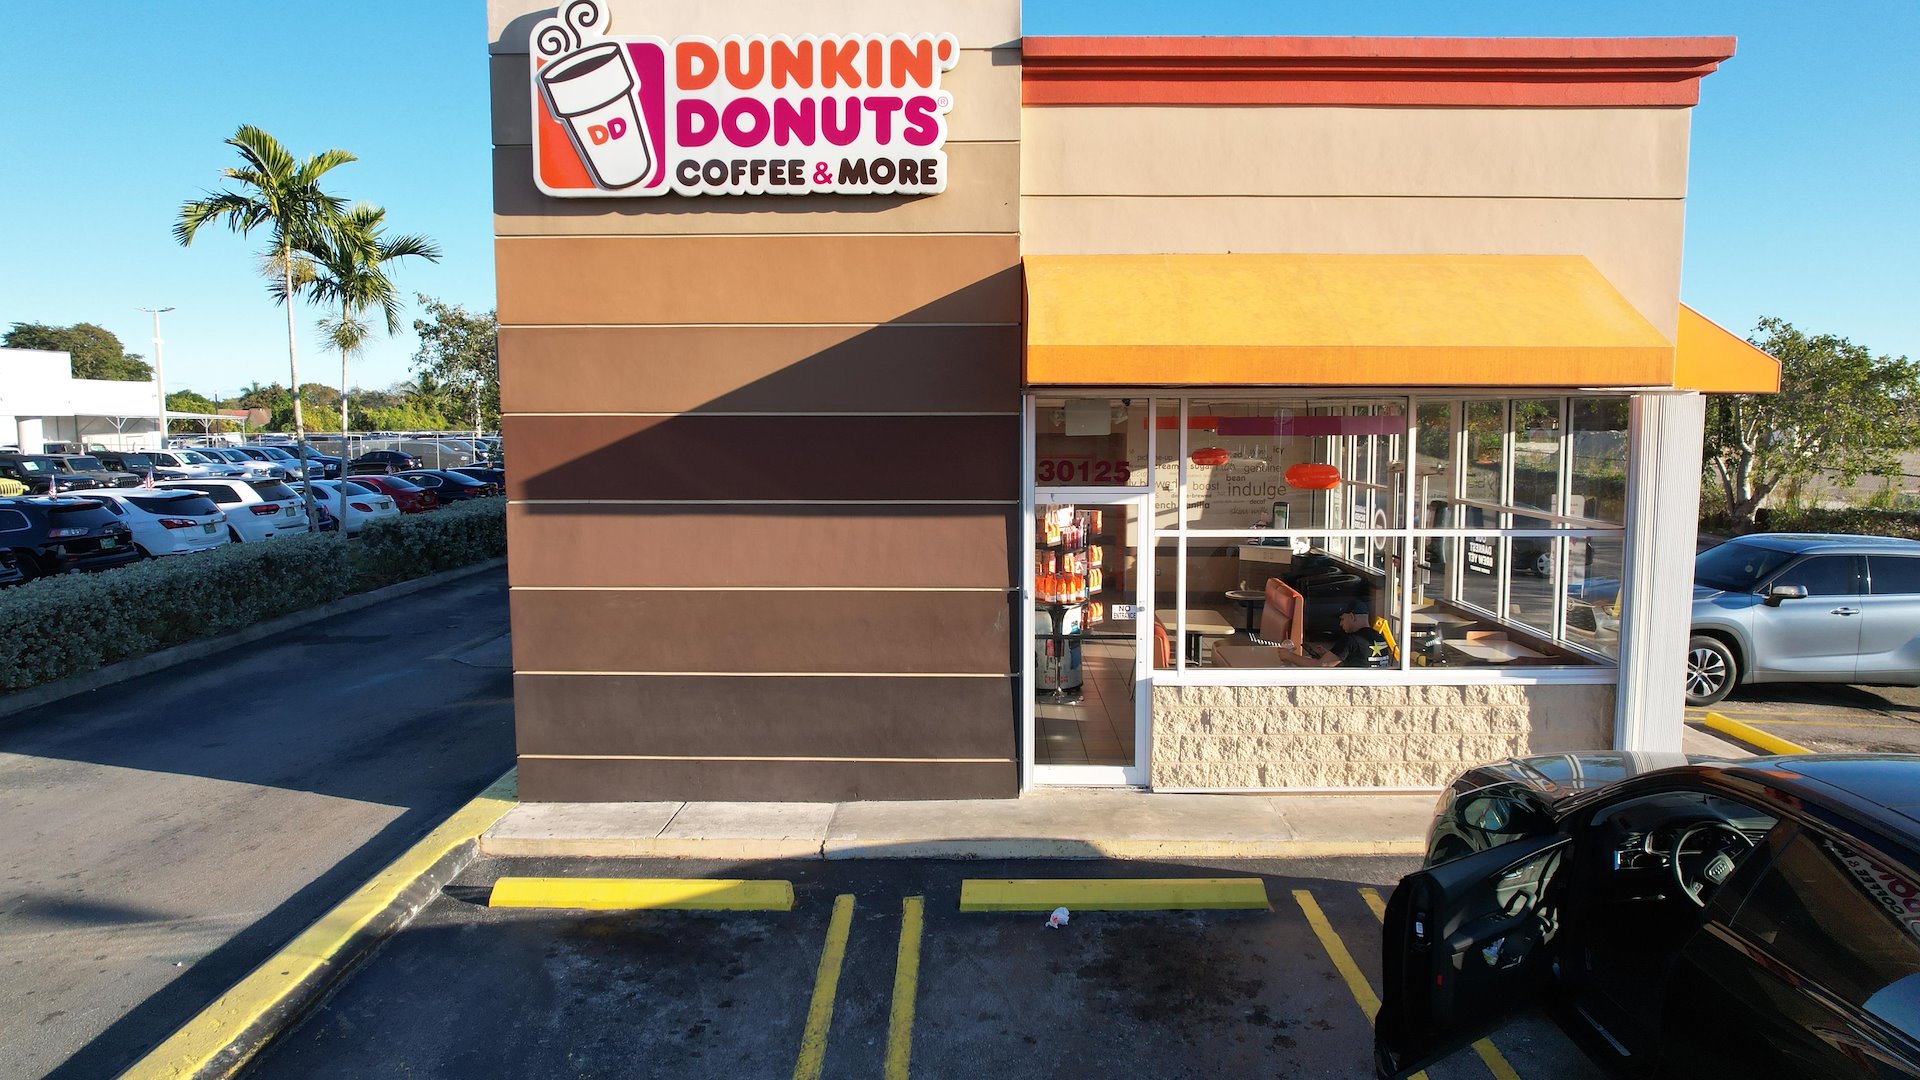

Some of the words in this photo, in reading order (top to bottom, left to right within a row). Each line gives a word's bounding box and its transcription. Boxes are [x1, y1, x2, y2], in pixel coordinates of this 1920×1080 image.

[675, 38, 952, 91] DUNKIN'
[586, 117, 627, 146] DD
[676, 95, 939, 148] DONUTS
[675, 158, 806, 186] COFFEE
[813, 161, 833, 185] &
[837, 157, 938, 185] MORE
[1038, 460, 1131, 482] 30125
[1225, 474, 1246, 482] bean
[1192, 481, 1220, 491] boost
[1227, 481, 1287, 500] indulge
